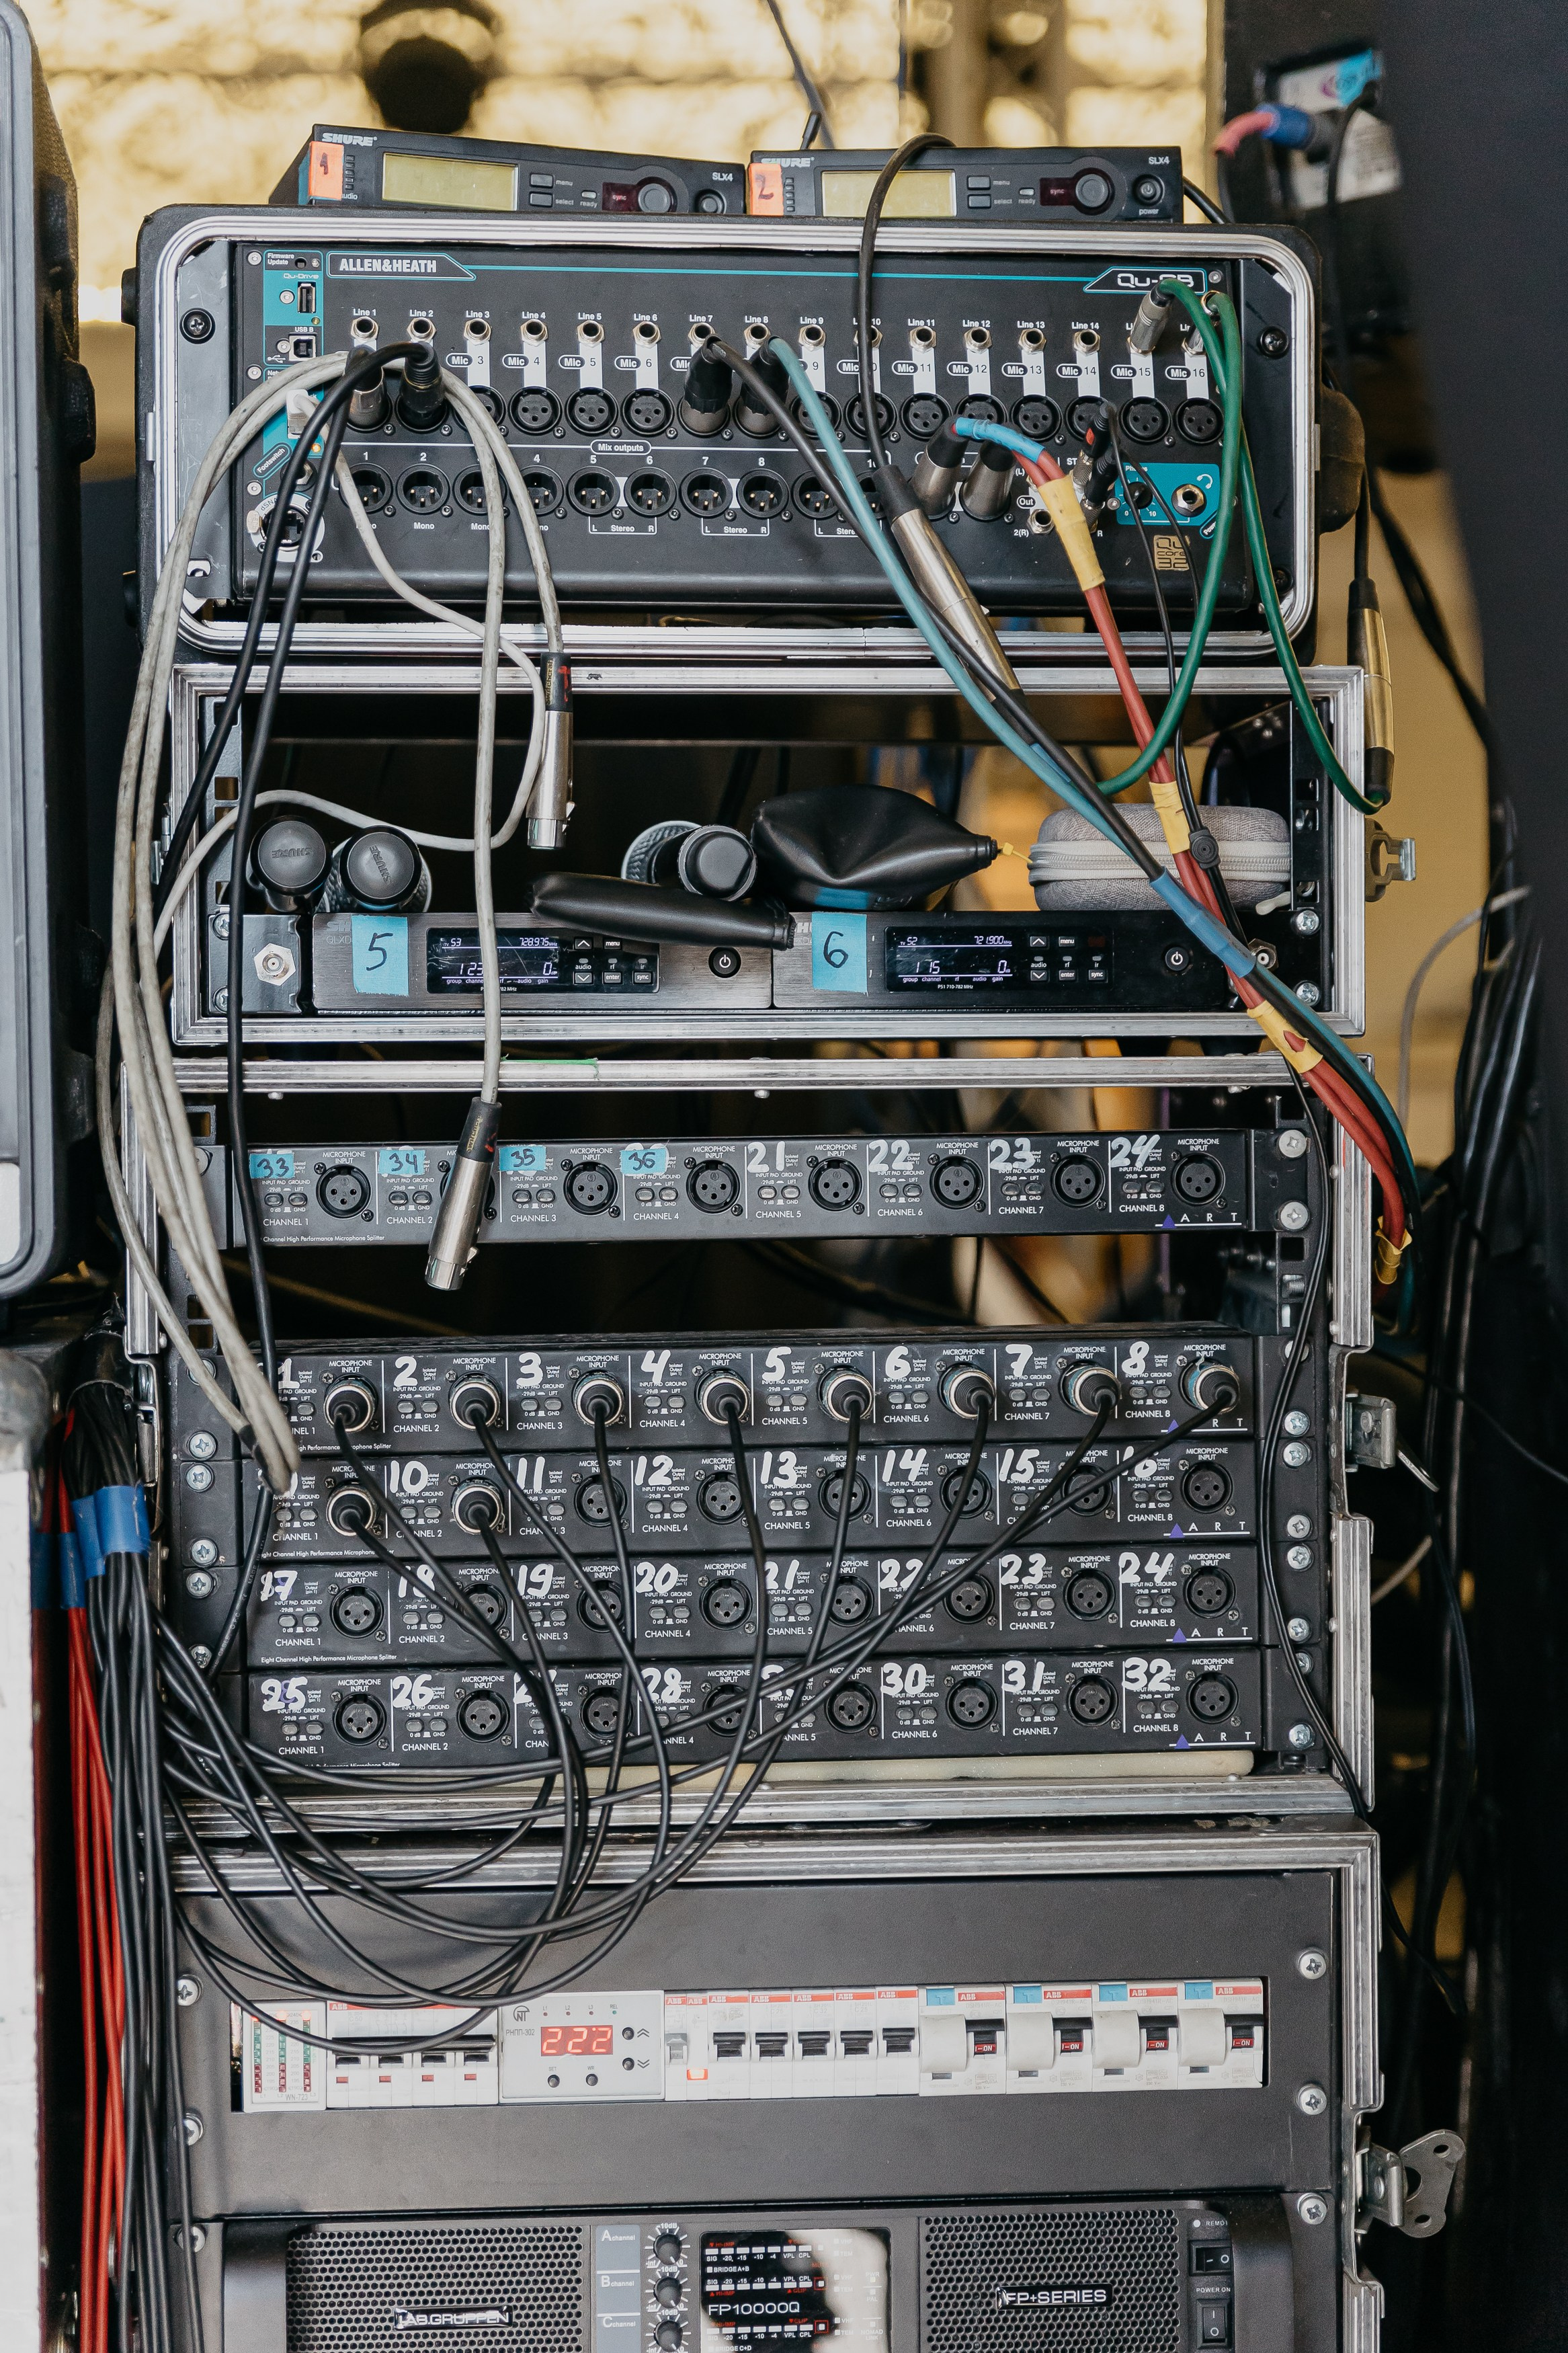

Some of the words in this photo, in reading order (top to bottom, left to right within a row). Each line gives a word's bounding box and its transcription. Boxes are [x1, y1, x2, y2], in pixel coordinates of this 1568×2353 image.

[322, 132, 373, 147] SHURE
[1149, 156, 1170, 165] SLX4
[712, 172, 733, 182] SLX4
[580, 200, 597, 208] ready
[339, 258, 436, 272] ALLEN&HEATH
[466, 310, 483, 318] Line
[578, 312, 595, 320] Line
[908, 319, 925, 327] Line
[452, 357, 469, 366] Mic
[478, 356, 483, 364] 3
[507, 358, 524, 367] Mic
[534, 357, 540, 365] 4
[620, 359, 636, 368] Mic
[646, 358, 652, 367] 6
[952, 364, 969, 373] Mic
[975, 364, 987, 373] 12
[1062, 366, 1079, 375] Mic
[1085, 366, 1096, 375] 14
[363, 452, 368, 461] 1
[420, 452, 427, 461] 2
[598, 443, 612, 451] Mix
[614, 444, 644, 452] outputs
[256, 446, 286, 474] Footswitch
[590, 455, 597, 464] 5
[647, 456, 653, 465] 6
[702, 456, 708, 465] 7
[758, 457, 765, 467] 8
[366, 932, 393, 971] 5
[823, 931, 848, 968] 6
[510, 1149, 536, 1168] 35
[628, 1151, 656, 1170] 36
[747, 1141, 785, 1173] 21
[869, 1140, 913, 1172] 22
[990, 1138, 1036, 1170] 23
[1110, 1135, 1160, 1167] 24
[257, 1157, 289, 1178] 33
[388, 1153, 418, 1173] 34
[1119, 1204, 1157, 1212] CHANNEL
[641, 1350, 671, 1383] 4
[761, 1347, 792, 1382] 5
[885, 1346, 911, 1379] 6
[1005, 1344, 1032, 1378] 7
[1122, 1341, 1150, 1376] 8
[394, 1356, 418, 1387] 2
[516, 1353, 544, 1386] 3
[393, 1425, 432, 1433] CHANNEL
[634, 1455, 673, 1486] 12
[761, 1451, 797, 1488] 13
[883, 1449, 927, 1482] 14
[999, 1449, 1039, 1482] 15
[390, 1460, 429, 1493] 10
[636, 1562, 679, 1593] 20
[1001, 1554, 1046, 1585] 23
[1120, 1552, 1175, 1583] 24
[518, 1564, 554, 1596] 19
[881, 1663, 927, 1696] 30
[1003, 1660, 1045, 1692] 31
[1122, 1657, 1171, 1690] 32
[393, 1675, 434, 1708] 26
[1013, 1727, 1051, 1735] CHANNEL
[286, 2093, 308, 2101] WN-723
[708, 2302, 800, 2315] FP10000Q
